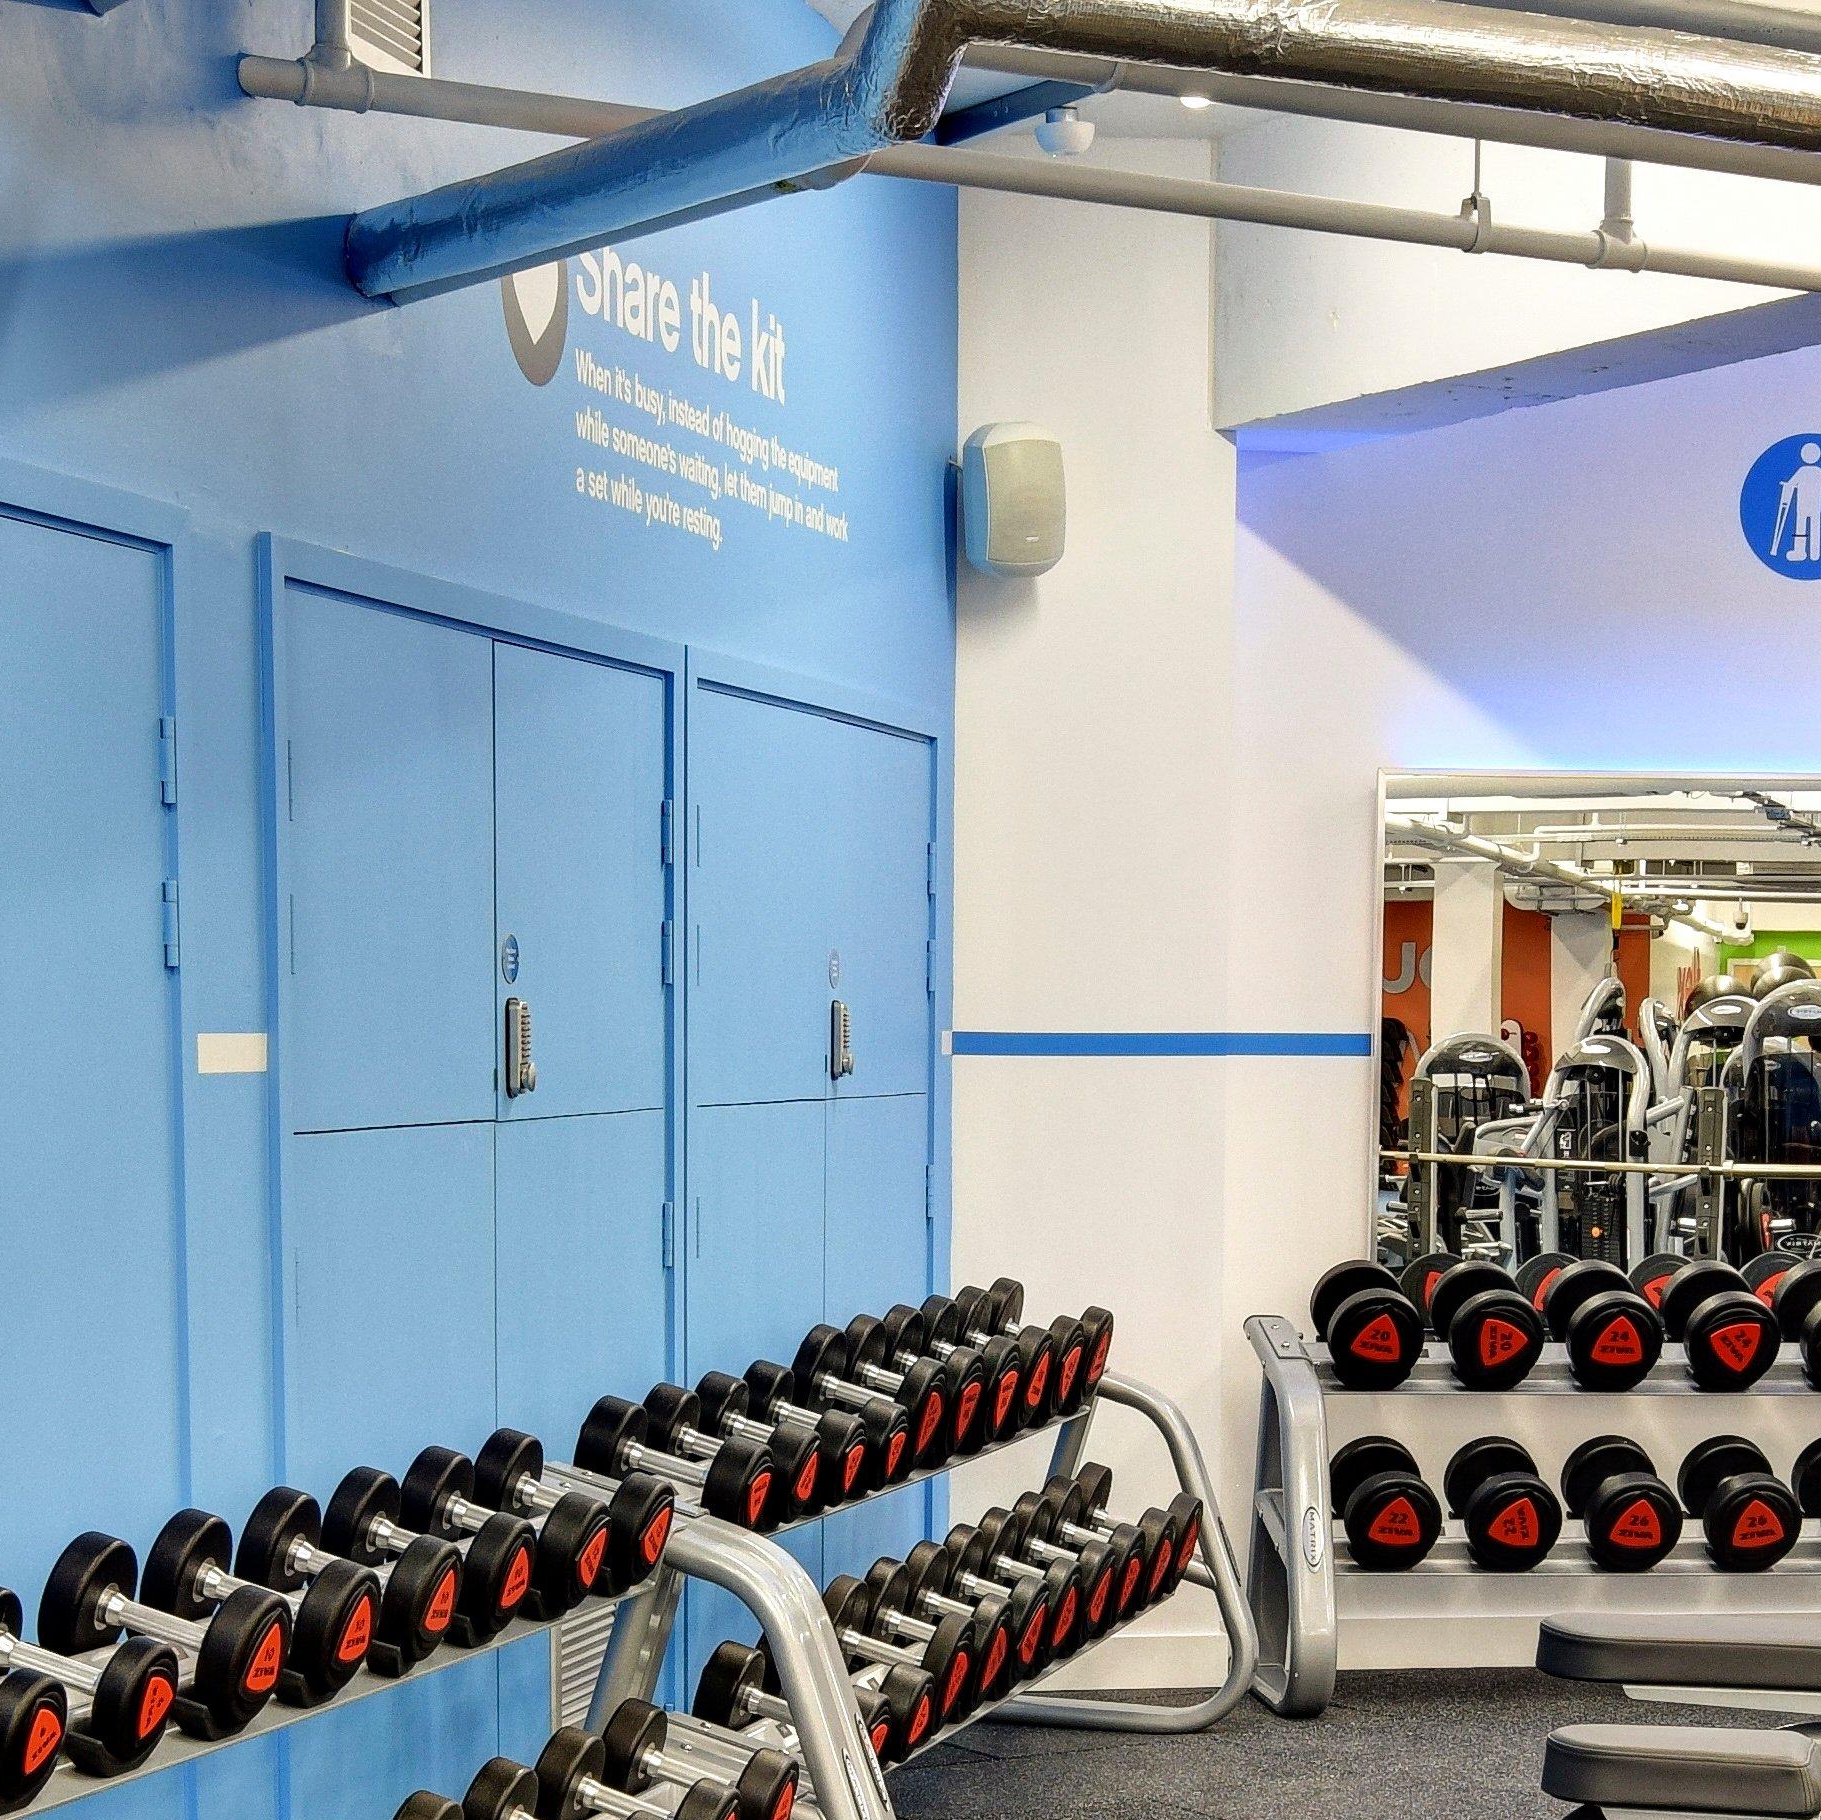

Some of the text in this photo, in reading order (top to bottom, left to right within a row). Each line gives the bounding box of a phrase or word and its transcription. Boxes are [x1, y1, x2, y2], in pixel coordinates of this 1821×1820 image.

[576, 247, 786, 406] Share the kit
[576, 347, 839, 492] When it's busy, instead of hogging the equipment
[576, 406, 848, 542] while someone's waiting, let them jump in and work
[576, 466, 724, 551] a set while you're resting.
[1371, 1329, 1391, 1342] 20
[1308, 1511, 1316, 1562] MATRIX
[1388, 1512, 1409, 1525] 22
[1628, 1515, 1649, 1527] 26
